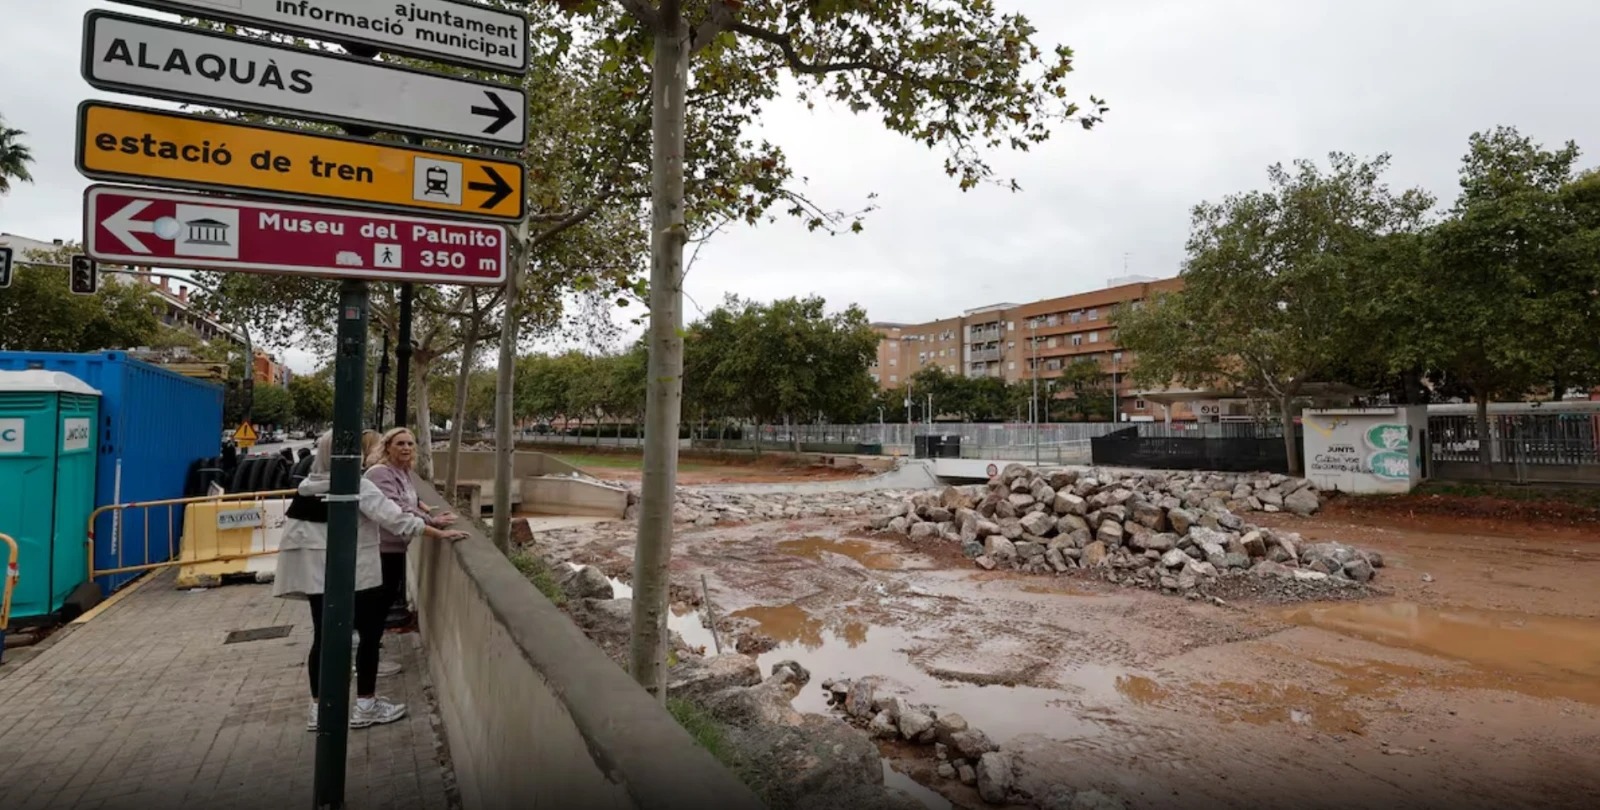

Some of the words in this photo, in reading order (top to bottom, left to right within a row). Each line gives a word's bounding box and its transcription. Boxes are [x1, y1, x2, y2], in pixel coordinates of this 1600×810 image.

[276, 0, 404, 36] informació
[415, 28, 517, 59] municipal
[395, 3, 517, 40] ajuntament
[103, 37, 314, 95] ALAQUÀS
[95, 132, 232, 166] estació
[250, 150, 291, 173] de
[309, 154, 374, 183] tren
[258, 211, 344, 236] Museu
[360, 222, 398, 240] del
[412, 224, 497, 248] Palmito
[420, 250, 466, 268] 350
[479, 257, 497, 271] m
